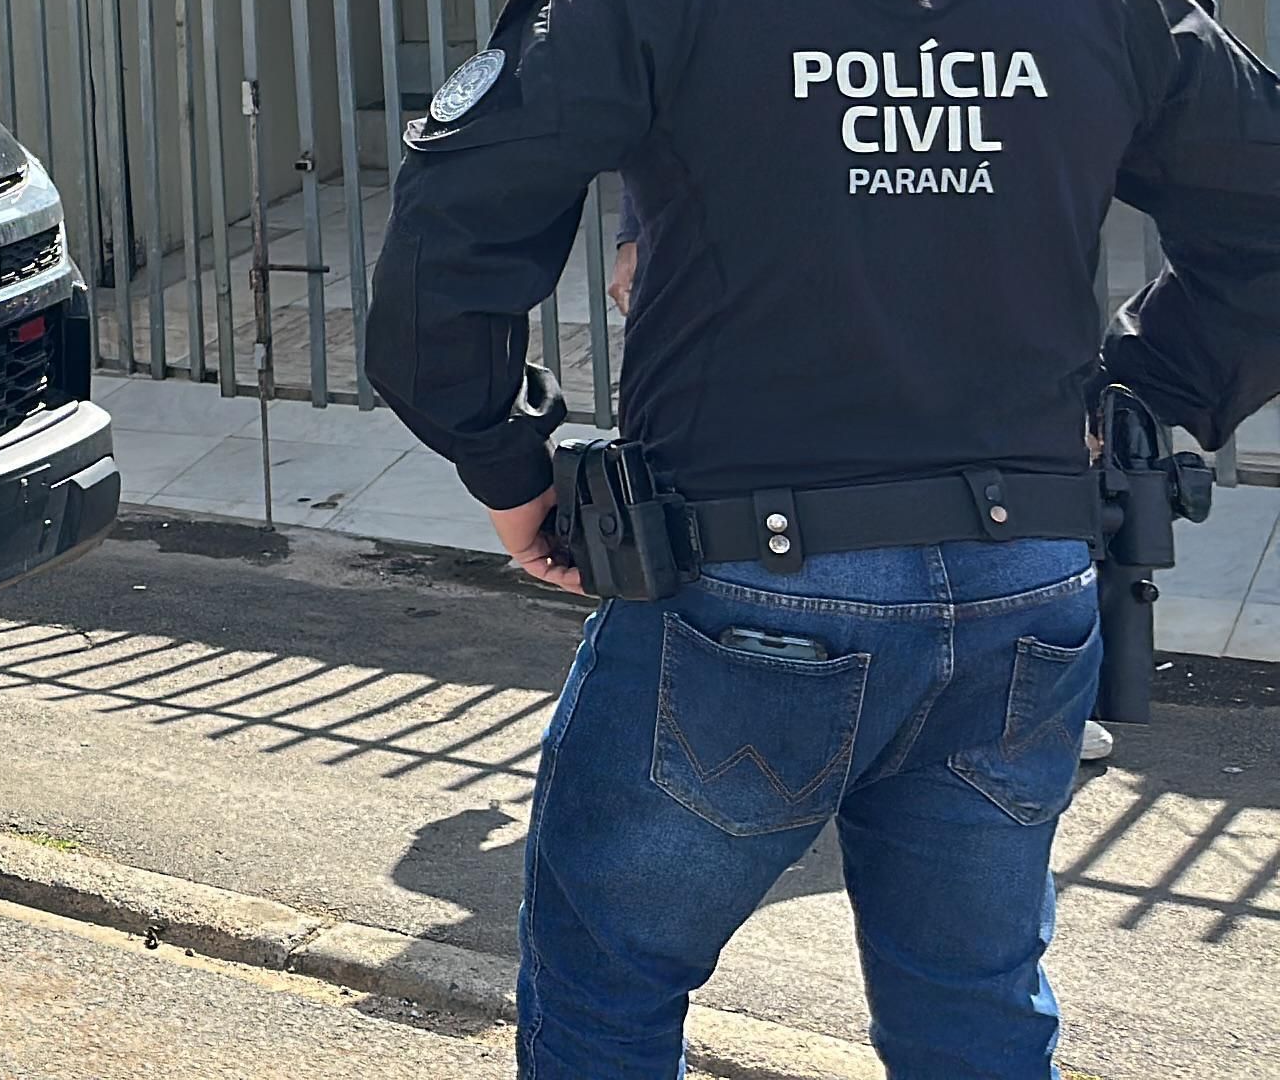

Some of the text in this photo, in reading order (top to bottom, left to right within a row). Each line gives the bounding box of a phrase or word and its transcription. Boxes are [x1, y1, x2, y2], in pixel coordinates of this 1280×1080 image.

[792, 38, 1049, 99] POLÍCIA
[841, 105, 1003, 153] CIVIL
[849, 161, 995, 195] PARANÁ
